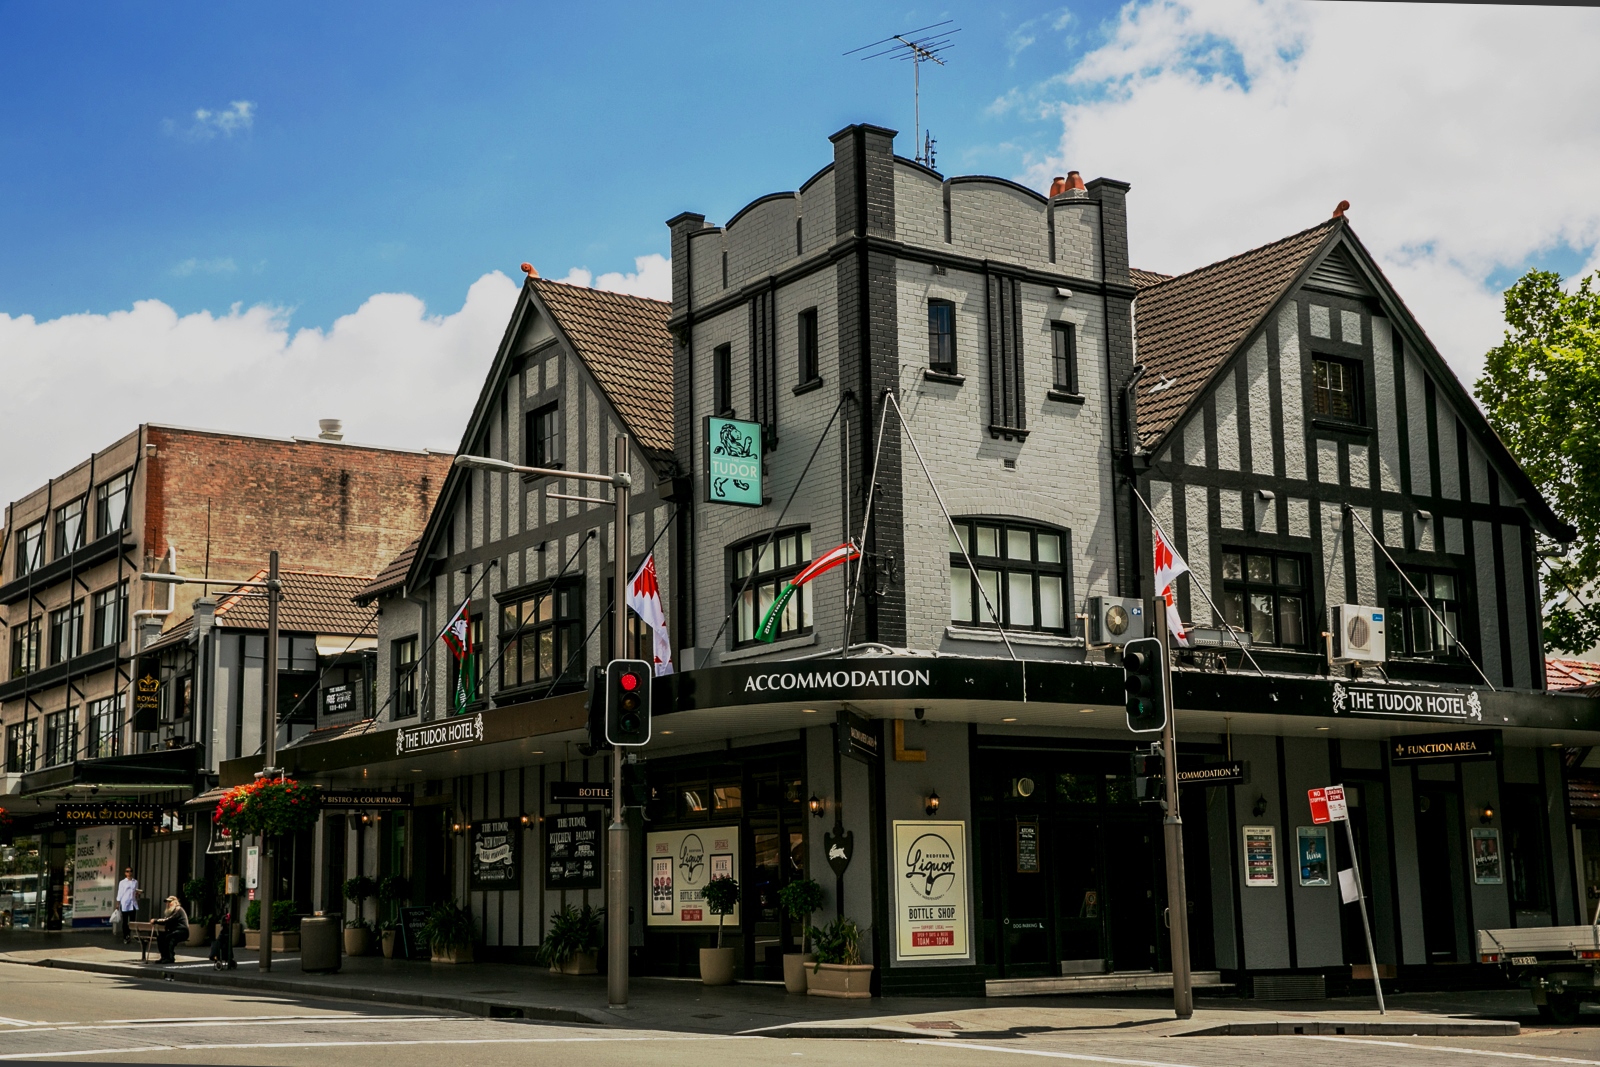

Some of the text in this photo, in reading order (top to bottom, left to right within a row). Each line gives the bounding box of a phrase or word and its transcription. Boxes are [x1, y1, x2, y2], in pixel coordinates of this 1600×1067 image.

[713, 461, 757, 478] TUDOR
[744, 669, 930, 692] ACCOMMODATION
[1349, 691, 1467, 715] THE TUDOR HOTEL
[405, 722, 474, 748] THE TUDOR HOTEL
[1407, 741, 1477, 755] FUNCTION AREA
[578, 788, 610, 797] BOTTLE
[327, 796, 402, 804] BISTRO & COURTYARD
[66, 810, 154, 820] ROYAL LOUNGE
[481, 821, 509, 833] THE TUDOR
[557, 816, 588, 829] THE TUDOR
[549, 831, 572, 844] KITCHEN
[575, 829, 596, 841] BALCONY
[77, 846, 94, 857] DISEASE
[76, 856, 108, 869] COMPOUNDING
[657, 863, 668, 871] BEER
[76, 870, 99, 882] PHARMACY
[908, 907, 956, 920] BOTTLE SHOP
[917, 938, 930, 946] 10AM
[936, 937, 949, 945] 10PM
